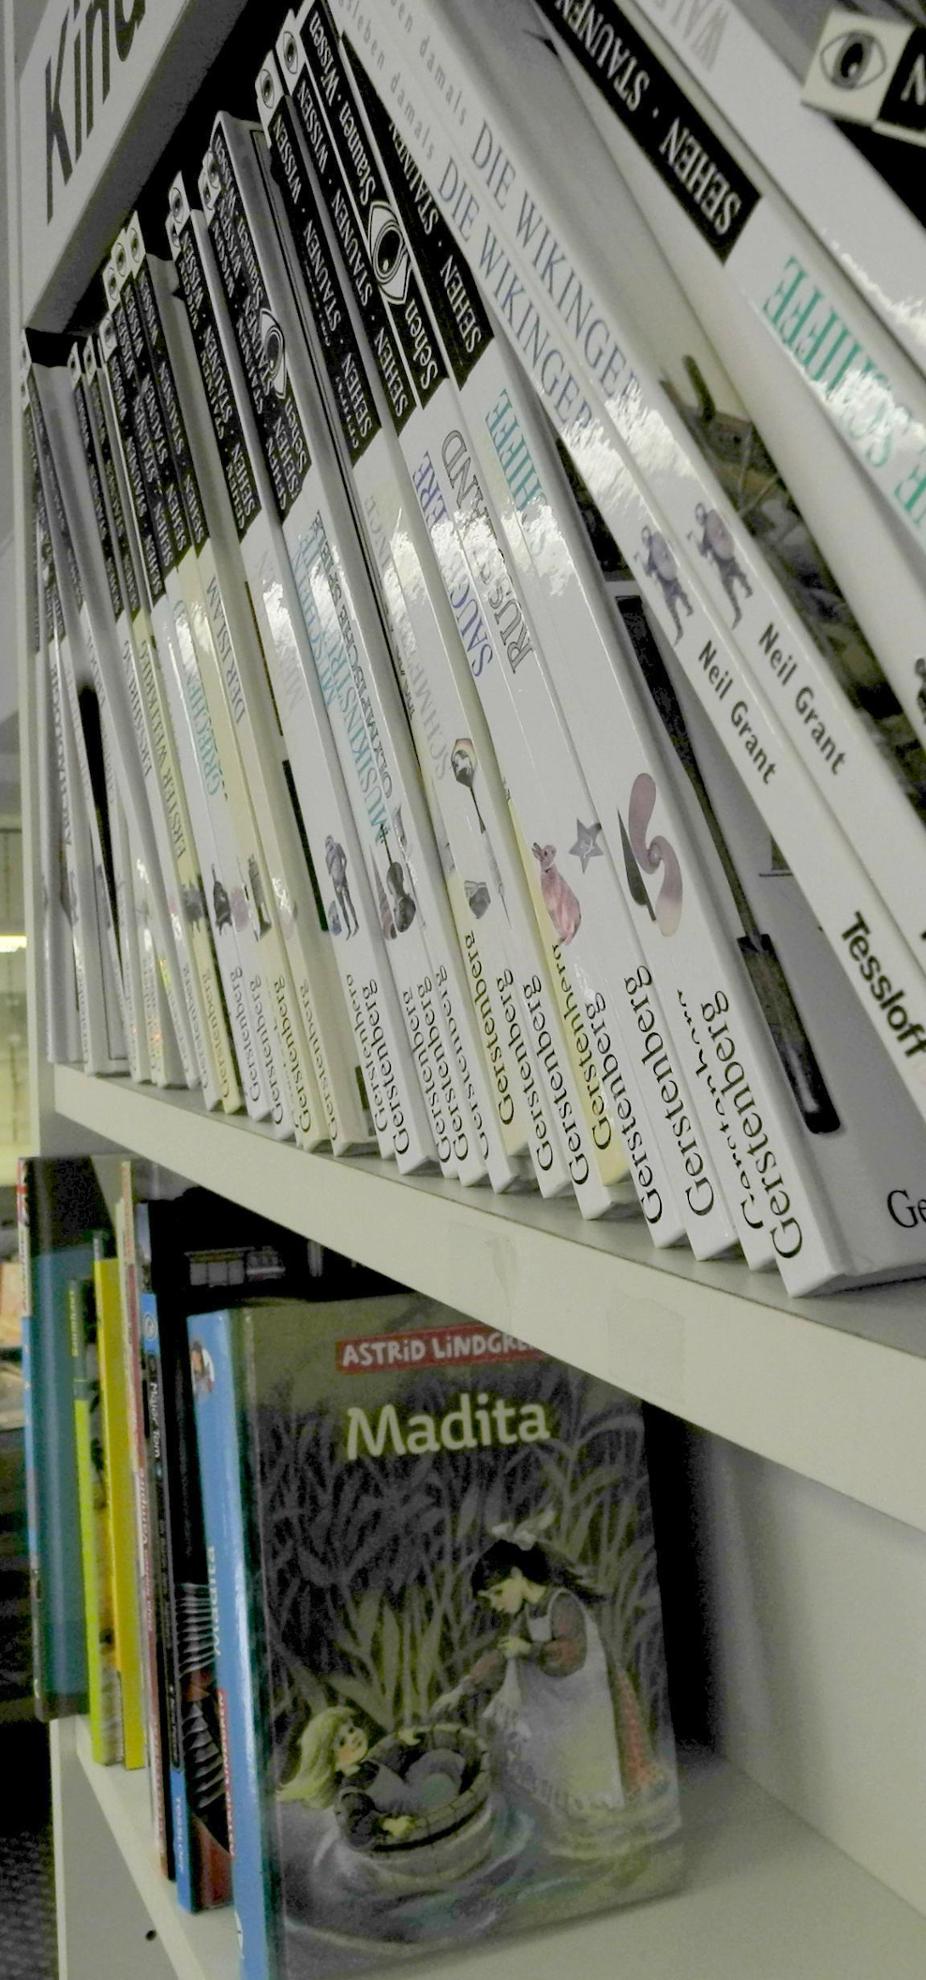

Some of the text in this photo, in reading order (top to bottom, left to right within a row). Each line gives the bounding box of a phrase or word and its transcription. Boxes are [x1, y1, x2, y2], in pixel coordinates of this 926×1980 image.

[273, 114, 302, 204] WISSEN
[297, 79, 329, 174] WISSEN
[390, 72, 435, 160] damals
[439, 157, 480, 242] DIE
[418, 35, 466, 126] damals
[472, 118, 516, 211] DIE
[659, 117, 742, 235] SEHEN
[308, 11, 438, 390] Sehen Staunen Wissen
[330, 188, 373, 306] STAUNEN
[303, 219, 342, 331] STAUNEN
[440, 254, 483, 353] SEHEN
[158, 361, 184, 455] STAUNEN
[180, 231, 255, 516] SEHEN STAUNEN WISSEN
[284, 398, 307, 473] Sehen
[341, 352, 372, 437] SEHEN
[374, 328, 409, 416] SEHEN
[166, 482, 187, 551] SEHEN
[184, 473, 205, 544] SEHEN
[273, 416, 299, 493] SEHEN
[153, 501, 174, 567] SEHEN
[206, 576, 246, 724] DER ISLAM
[699, 640, 776, 785] Neil Grant
[758, 623, 847, 776] Neil Grant
[230, 966, 261, 1103] Gerstenberg
[250, 975, 284, 1125] Gerstenberg
[274, 975, 312, 1133] Gerstenberg
[464, 929, 515, 1126] Gerstenberg
[841, 911, 926, 1058] Tessloff
[362, 978, 410, 1155] Gerstenberg
[402, 989, 452, 1164] Gerstenberg
[416, 975, 470, 1162] Gerstenberg
[496, 968, 554, 1172] Gerstenberg
[523, 974, 590, 1186] Gerstenberg
[583, 991, 664, 1225] Gerstenberg
[624, 965, 716, 1217] Gerstenberg
[700, 990, 803, 1259] Gerstenberg
[346, 1392, 550, 1461] Madita
